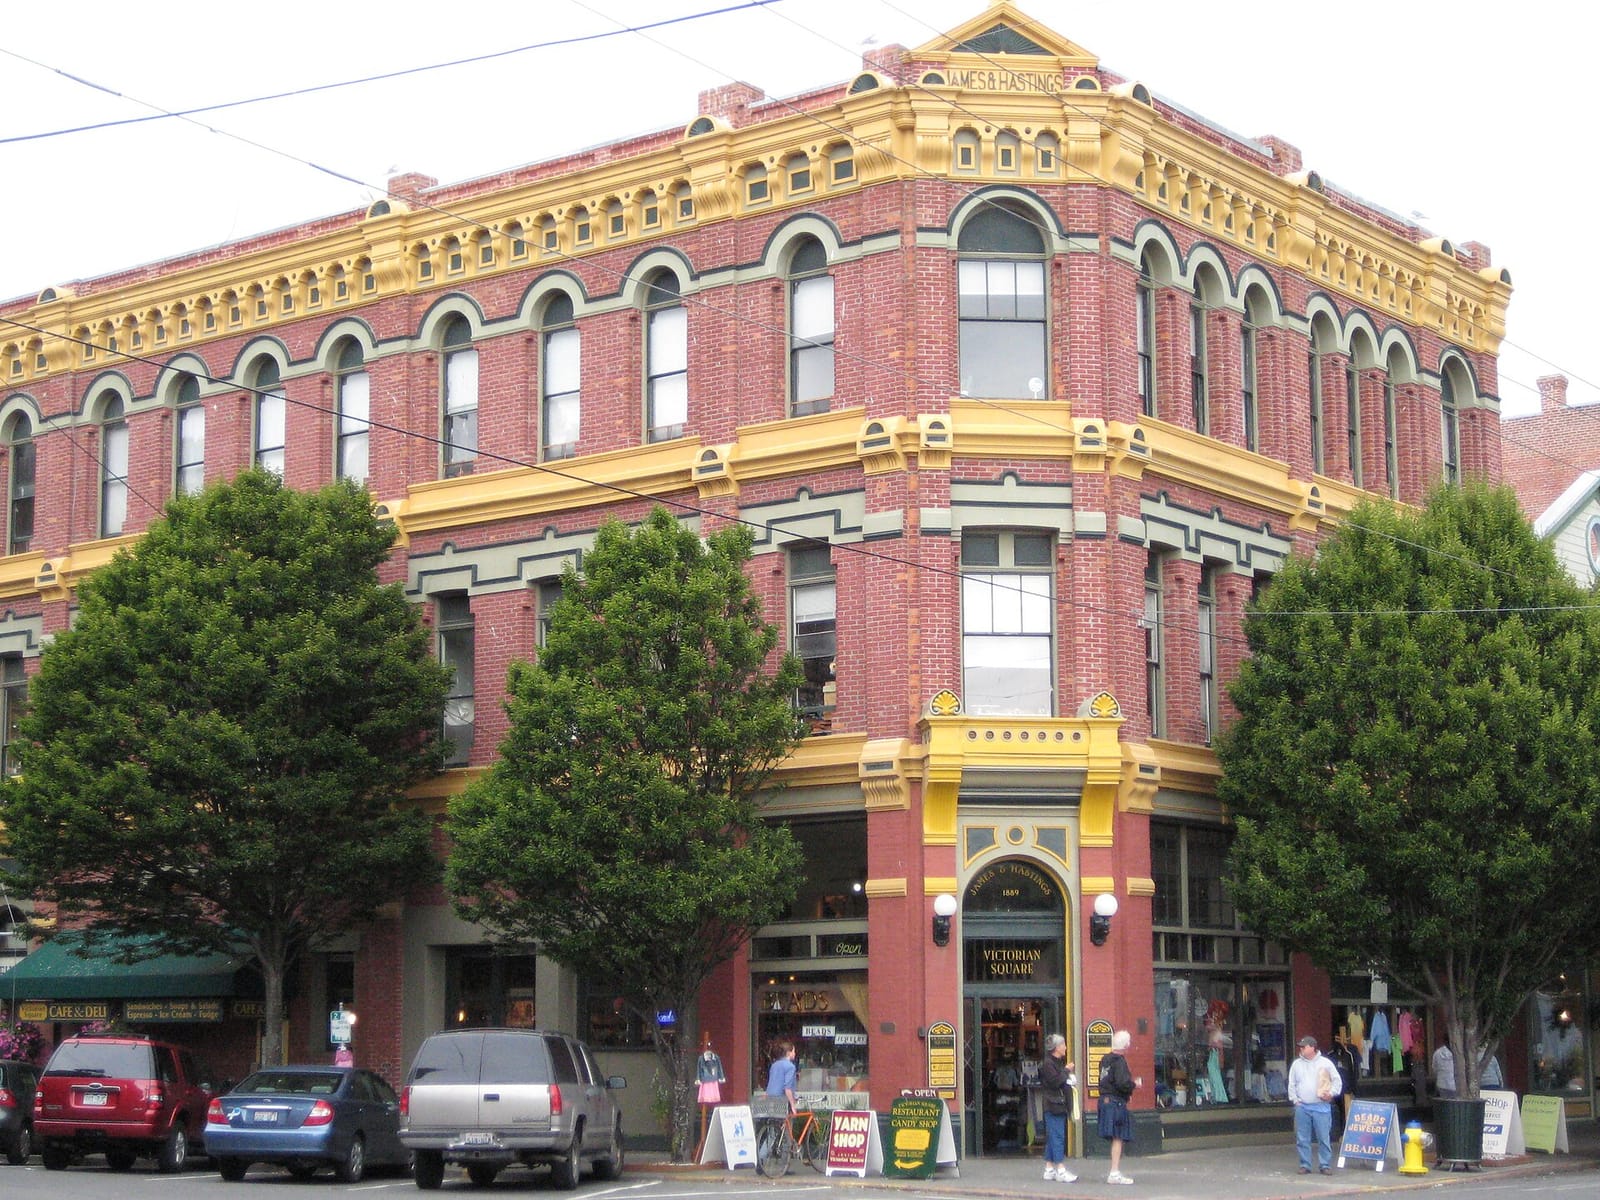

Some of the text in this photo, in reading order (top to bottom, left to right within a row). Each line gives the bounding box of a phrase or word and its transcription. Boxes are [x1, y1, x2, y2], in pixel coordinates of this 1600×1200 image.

[987, 71, 996, 90] &
[999, 71, 1063, 93] HASTINGS
[970, 871, 996, 896] JAMES
[1010, 864, 1053, 896] HASTINGS
[1002, 889, 1020, 897] 1889
[984, 950, 1041, 961] VICTORIAN
[990, 963, 1034, 975] SQUARE
[49, 1005, 107, 1018] CAFE & DELI
[159, 1010, 169, 1018] Ice
[171, 1010, 193, 1019] Cream
[199, 1010, 218, 1020] Fudge
[805, 1027, 832, 1036] BEADS
[914, 1089, 937, 1098] OPEN
[1485, 1097, 1509, 1110] SHOP
[892, 1107, 940, 1118] RESTAURANT
[834, 1116, 869, 1132] YARN
[891, 1119, 938, 1129] CANDY SHOP
[1354, 1113, 1386, 1125] BEADS
[1348, 1123, 1387, 1134] JEWELRY
[833, 1133, 865, 1148] SHOP
[1344, 1143, 1383, 1155] BEADS
